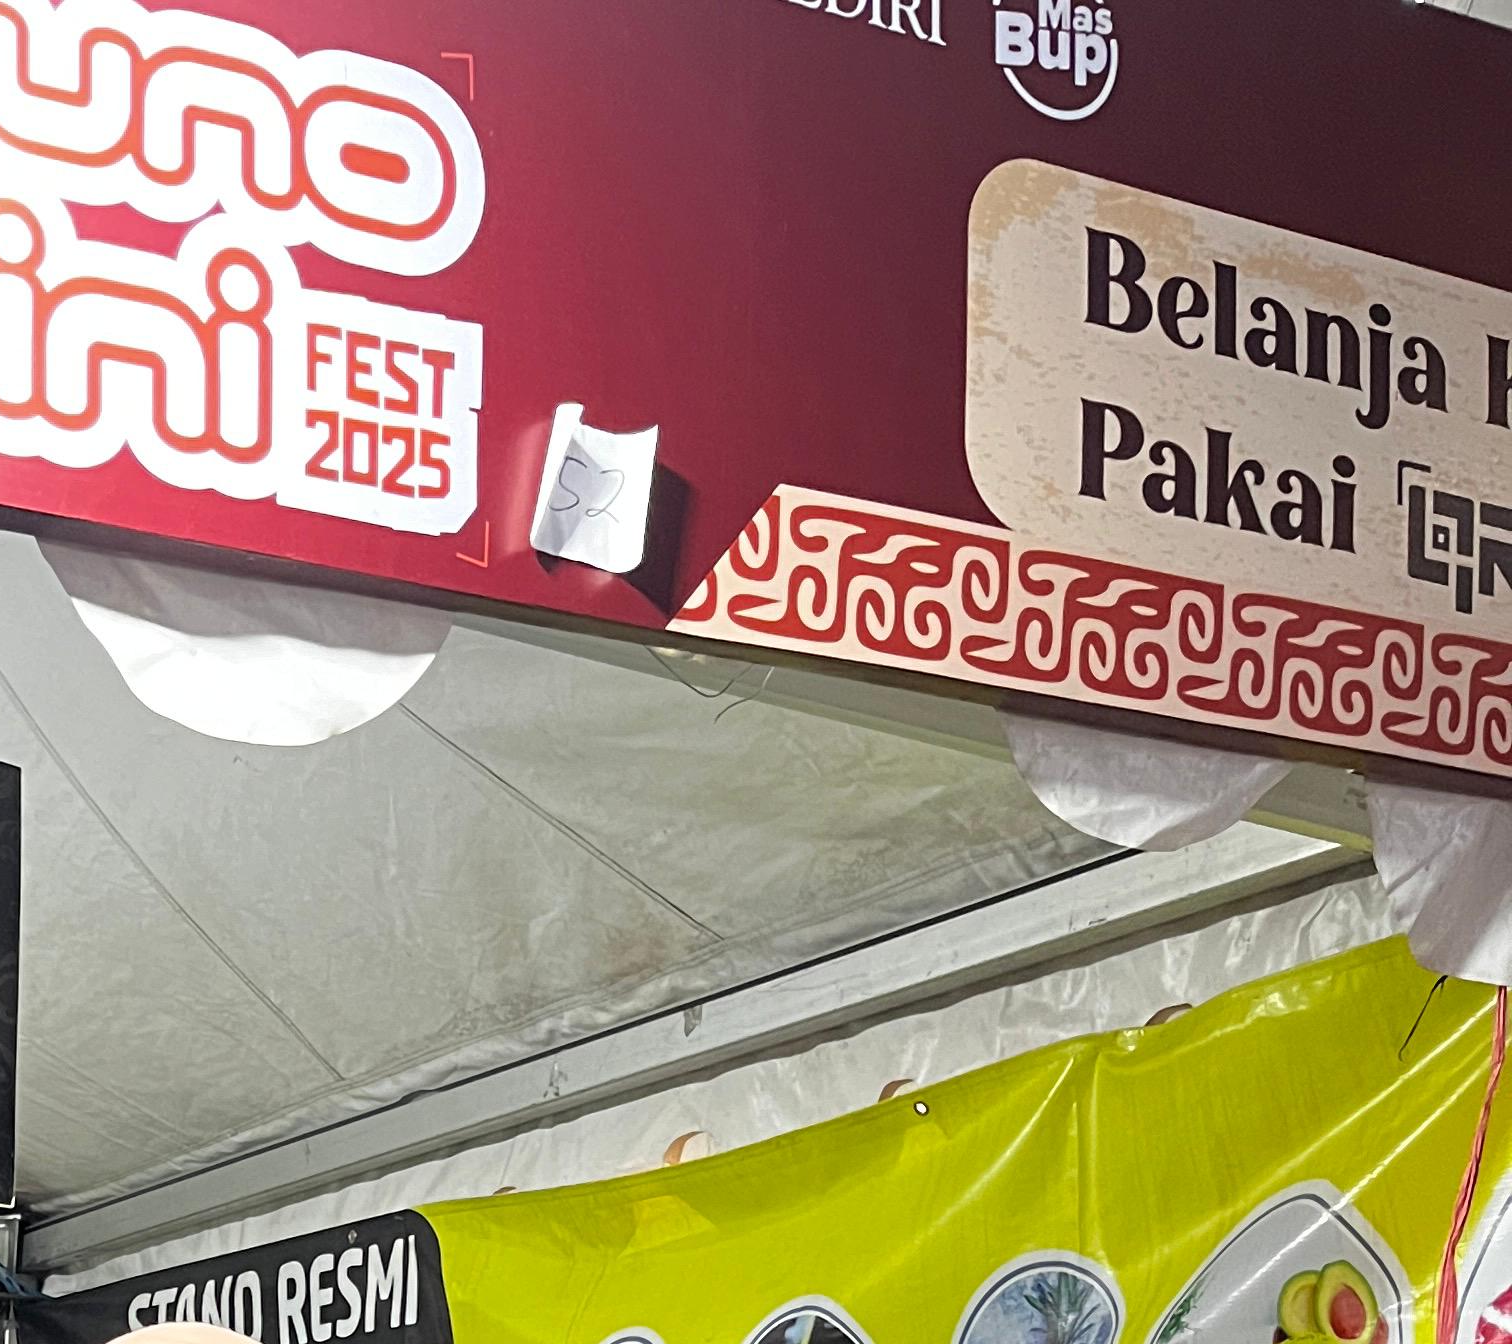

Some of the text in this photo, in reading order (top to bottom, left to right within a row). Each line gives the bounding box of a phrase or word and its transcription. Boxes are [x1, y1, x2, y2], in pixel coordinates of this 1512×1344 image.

[995, 10, 1109, 86] Bup
[305, 323, 456, 420] FEST
[1084, 226, 1449, 430] Belanja
[304, 409, 452, 500] 2025
[1079, 396, 1358, 556] Pakai
